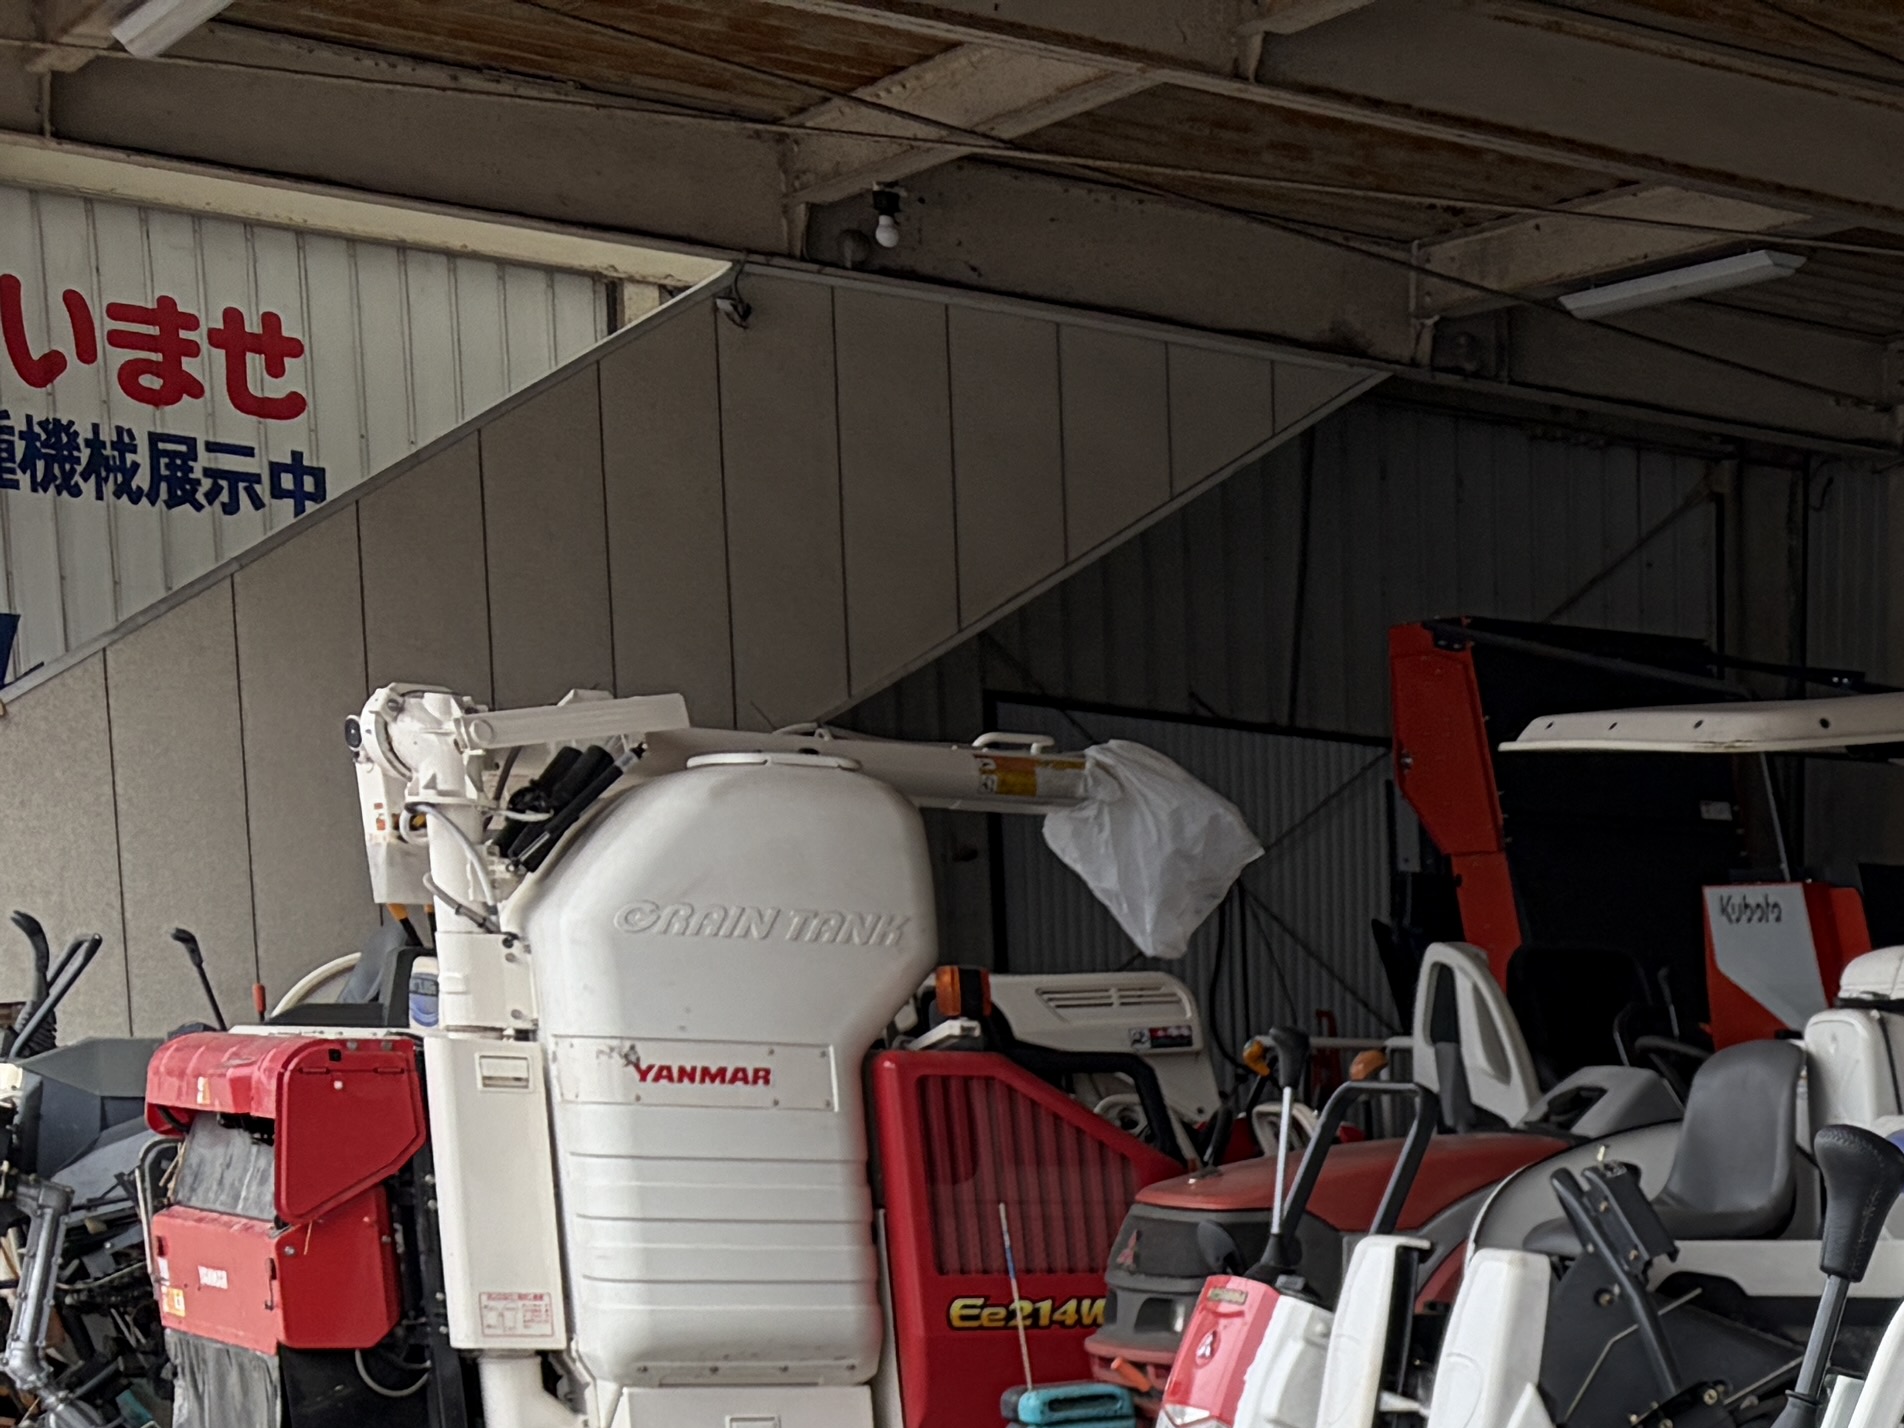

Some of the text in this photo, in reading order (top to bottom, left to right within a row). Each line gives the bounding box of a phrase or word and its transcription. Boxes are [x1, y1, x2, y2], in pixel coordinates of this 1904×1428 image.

[0, 273, 308, 421] いませ
[1719, 893, 1782, 924] Kubota
[632, 1063, 772, 1087] YANMAR
